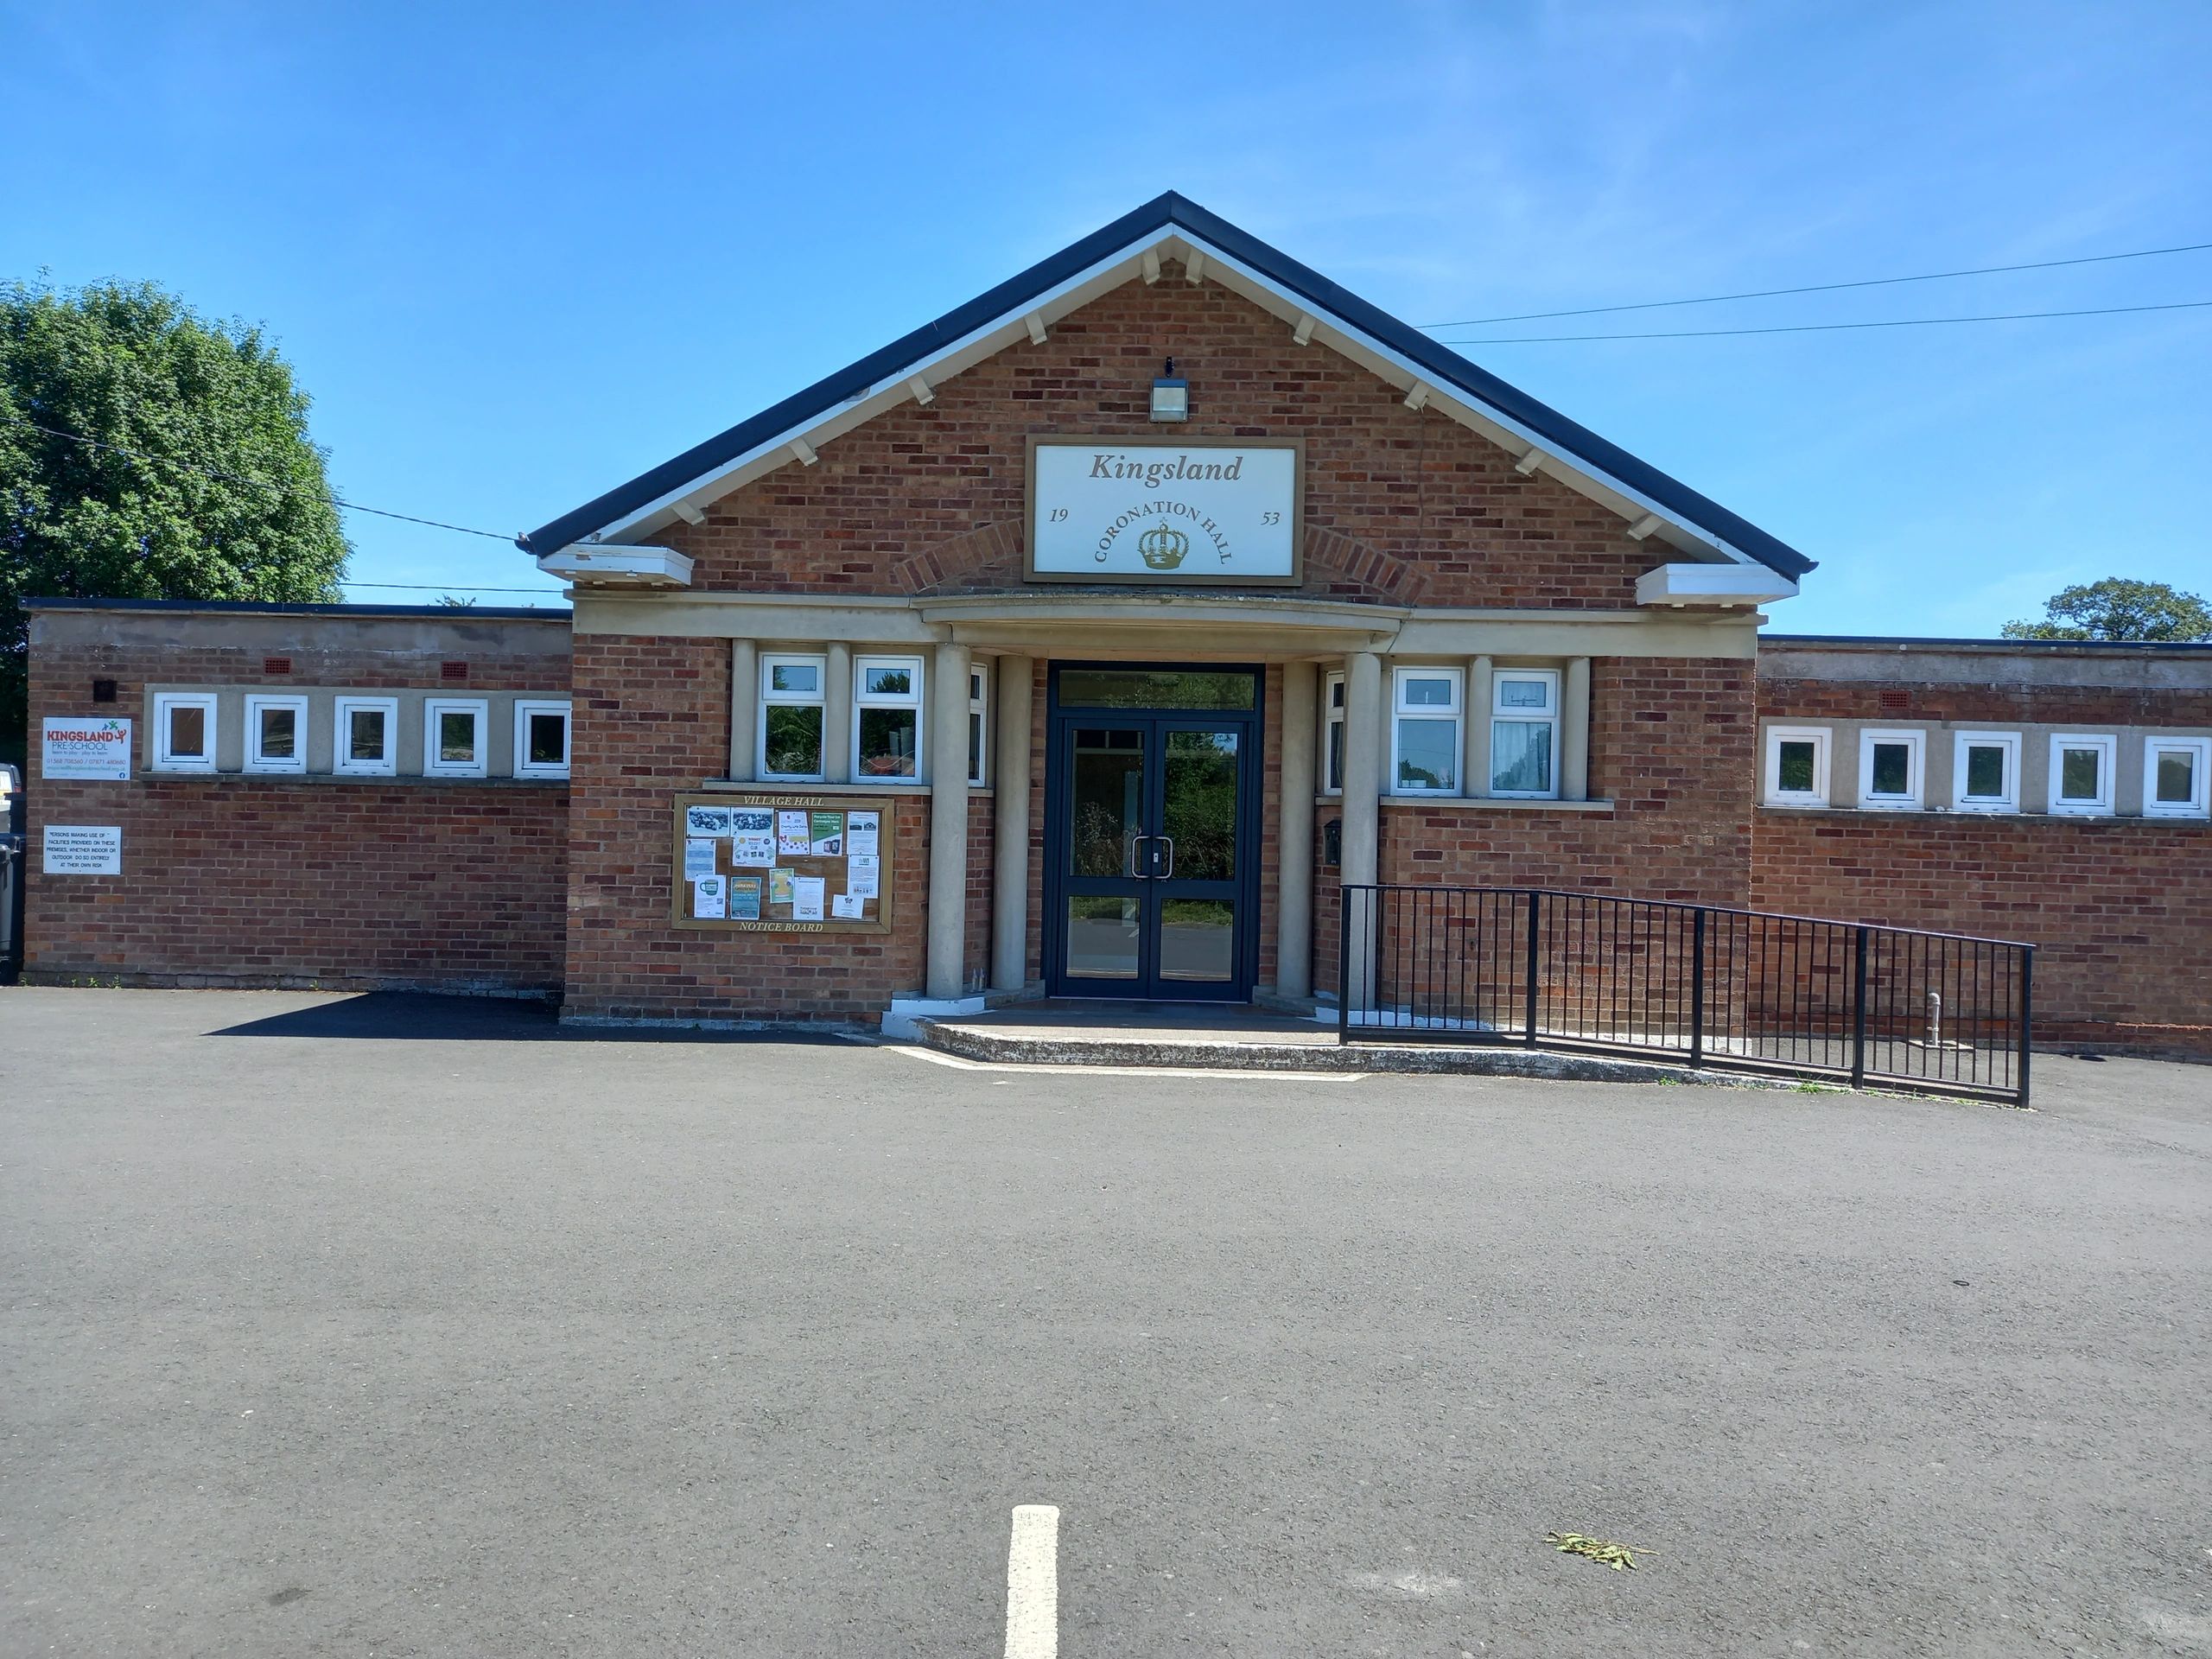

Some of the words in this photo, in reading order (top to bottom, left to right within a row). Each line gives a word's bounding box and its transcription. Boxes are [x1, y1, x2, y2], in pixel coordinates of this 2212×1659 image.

[1089, 454, 1243, 488] Kingsland
[1049, 508, 1069, 523] 19
[1261, 512, 1281, 525] 53
[1095, 501, 1201, 563] CORONATION
[1200, 518, 1233, 564] HALL
[47, 731, 114, 741] KINGSLAND
[52, 741, 108, 750] PRE-SCHOOL
[743, 796, 792, 805] VILLAGE
[793, 797, 824, 806] HALL
[740, 922, 783, 931] NOTICE
[784, 923, 823, 932] BOARD
